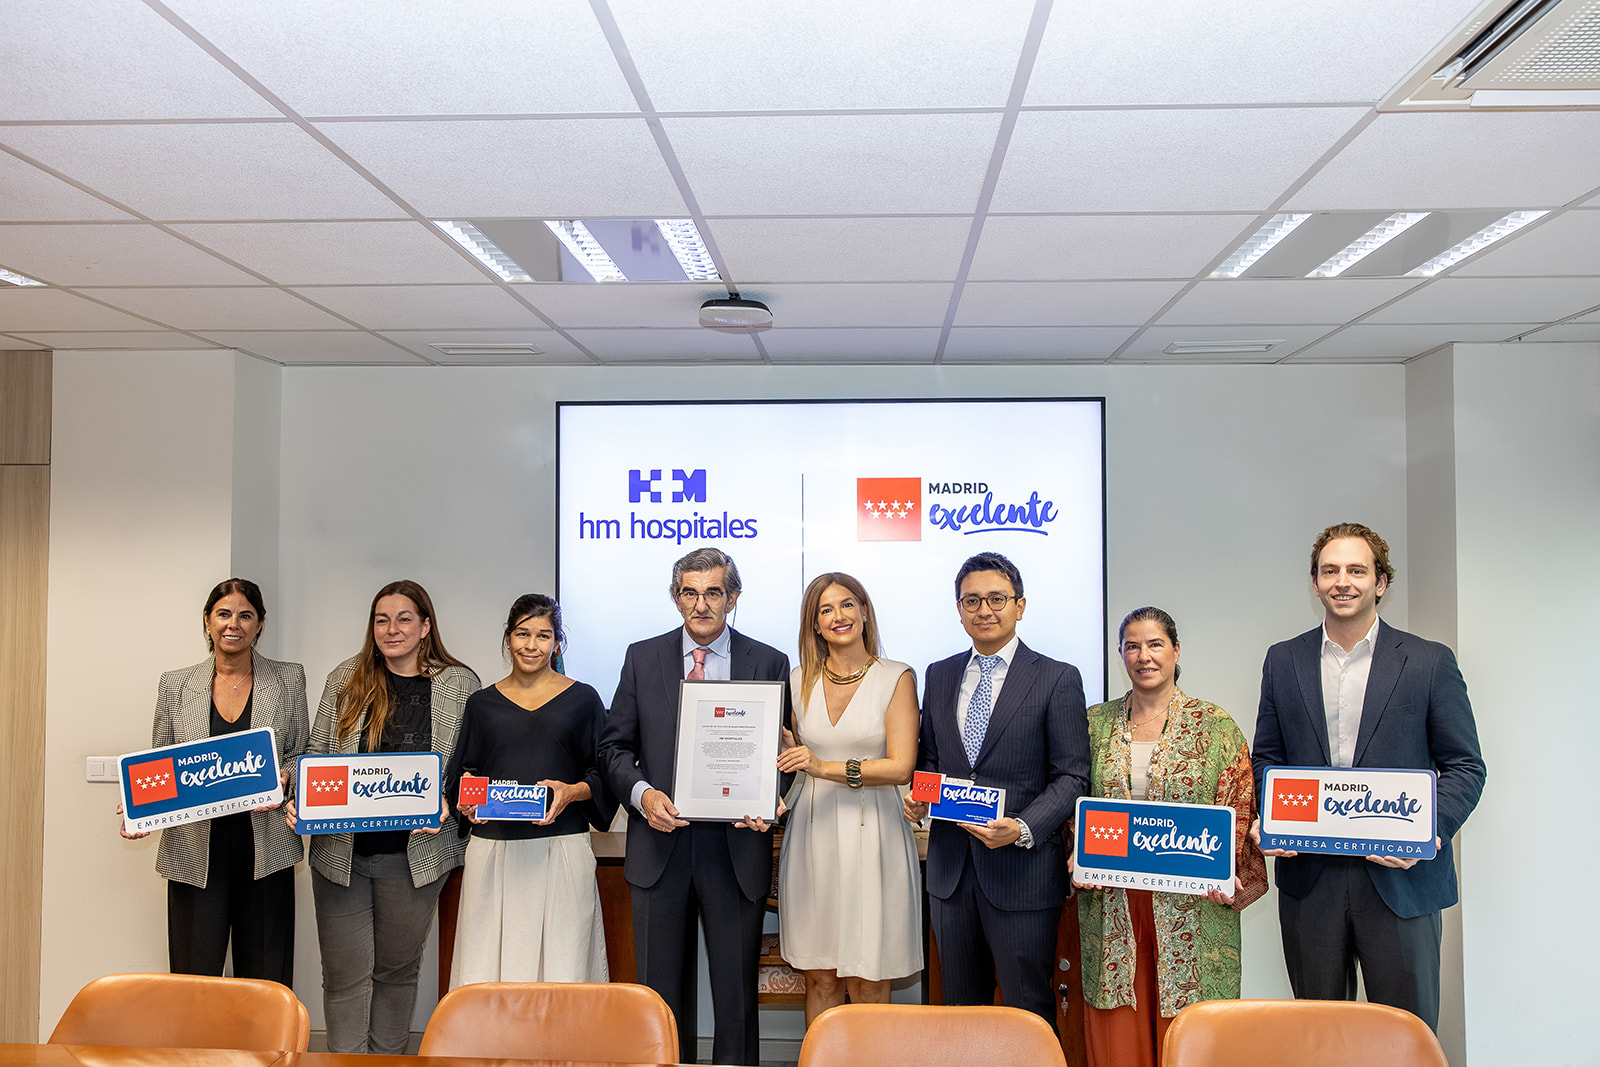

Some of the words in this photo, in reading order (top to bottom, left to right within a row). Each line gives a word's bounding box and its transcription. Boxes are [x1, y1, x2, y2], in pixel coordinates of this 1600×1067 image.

[928, 482, 989, 495] MADRID
[929, 490, 1059, 531] excelente
[579, 511, 621, 539] hm
[630, 511, 758, 545] hospitales
[178, 751, 219, 767] MADRID
[180, 750, 267, 788] excelente
[352, 767, 391, 776] MADRID
[352, 772, 432, 798] excelente
[490, 784, 546, 802] excelente
[942, 785, 1001, 805] excelente
[1324, 783, 1369, 793] MADRID
[137, 812, 191, 830] EMPRESA
[196, 795, 273, 817] CERTIFICADA
[1324, 790, 1422, 817] excelente
[306, 821, 356, 831] EMPRESA
[361, 818, 432, 828] CERTIFICADA
[1133, 816, 1175, 828] MADRID
[1132, 826, 1223, 855] excelente
[1271, 838, 1327, 849] EMPRESA
[1334, 841, 1423, 854] CERTIFICADA
[1084, 872, 1136, 884] EMPRESA
[1142, 877, 1222, 892] CERTIFICADA
